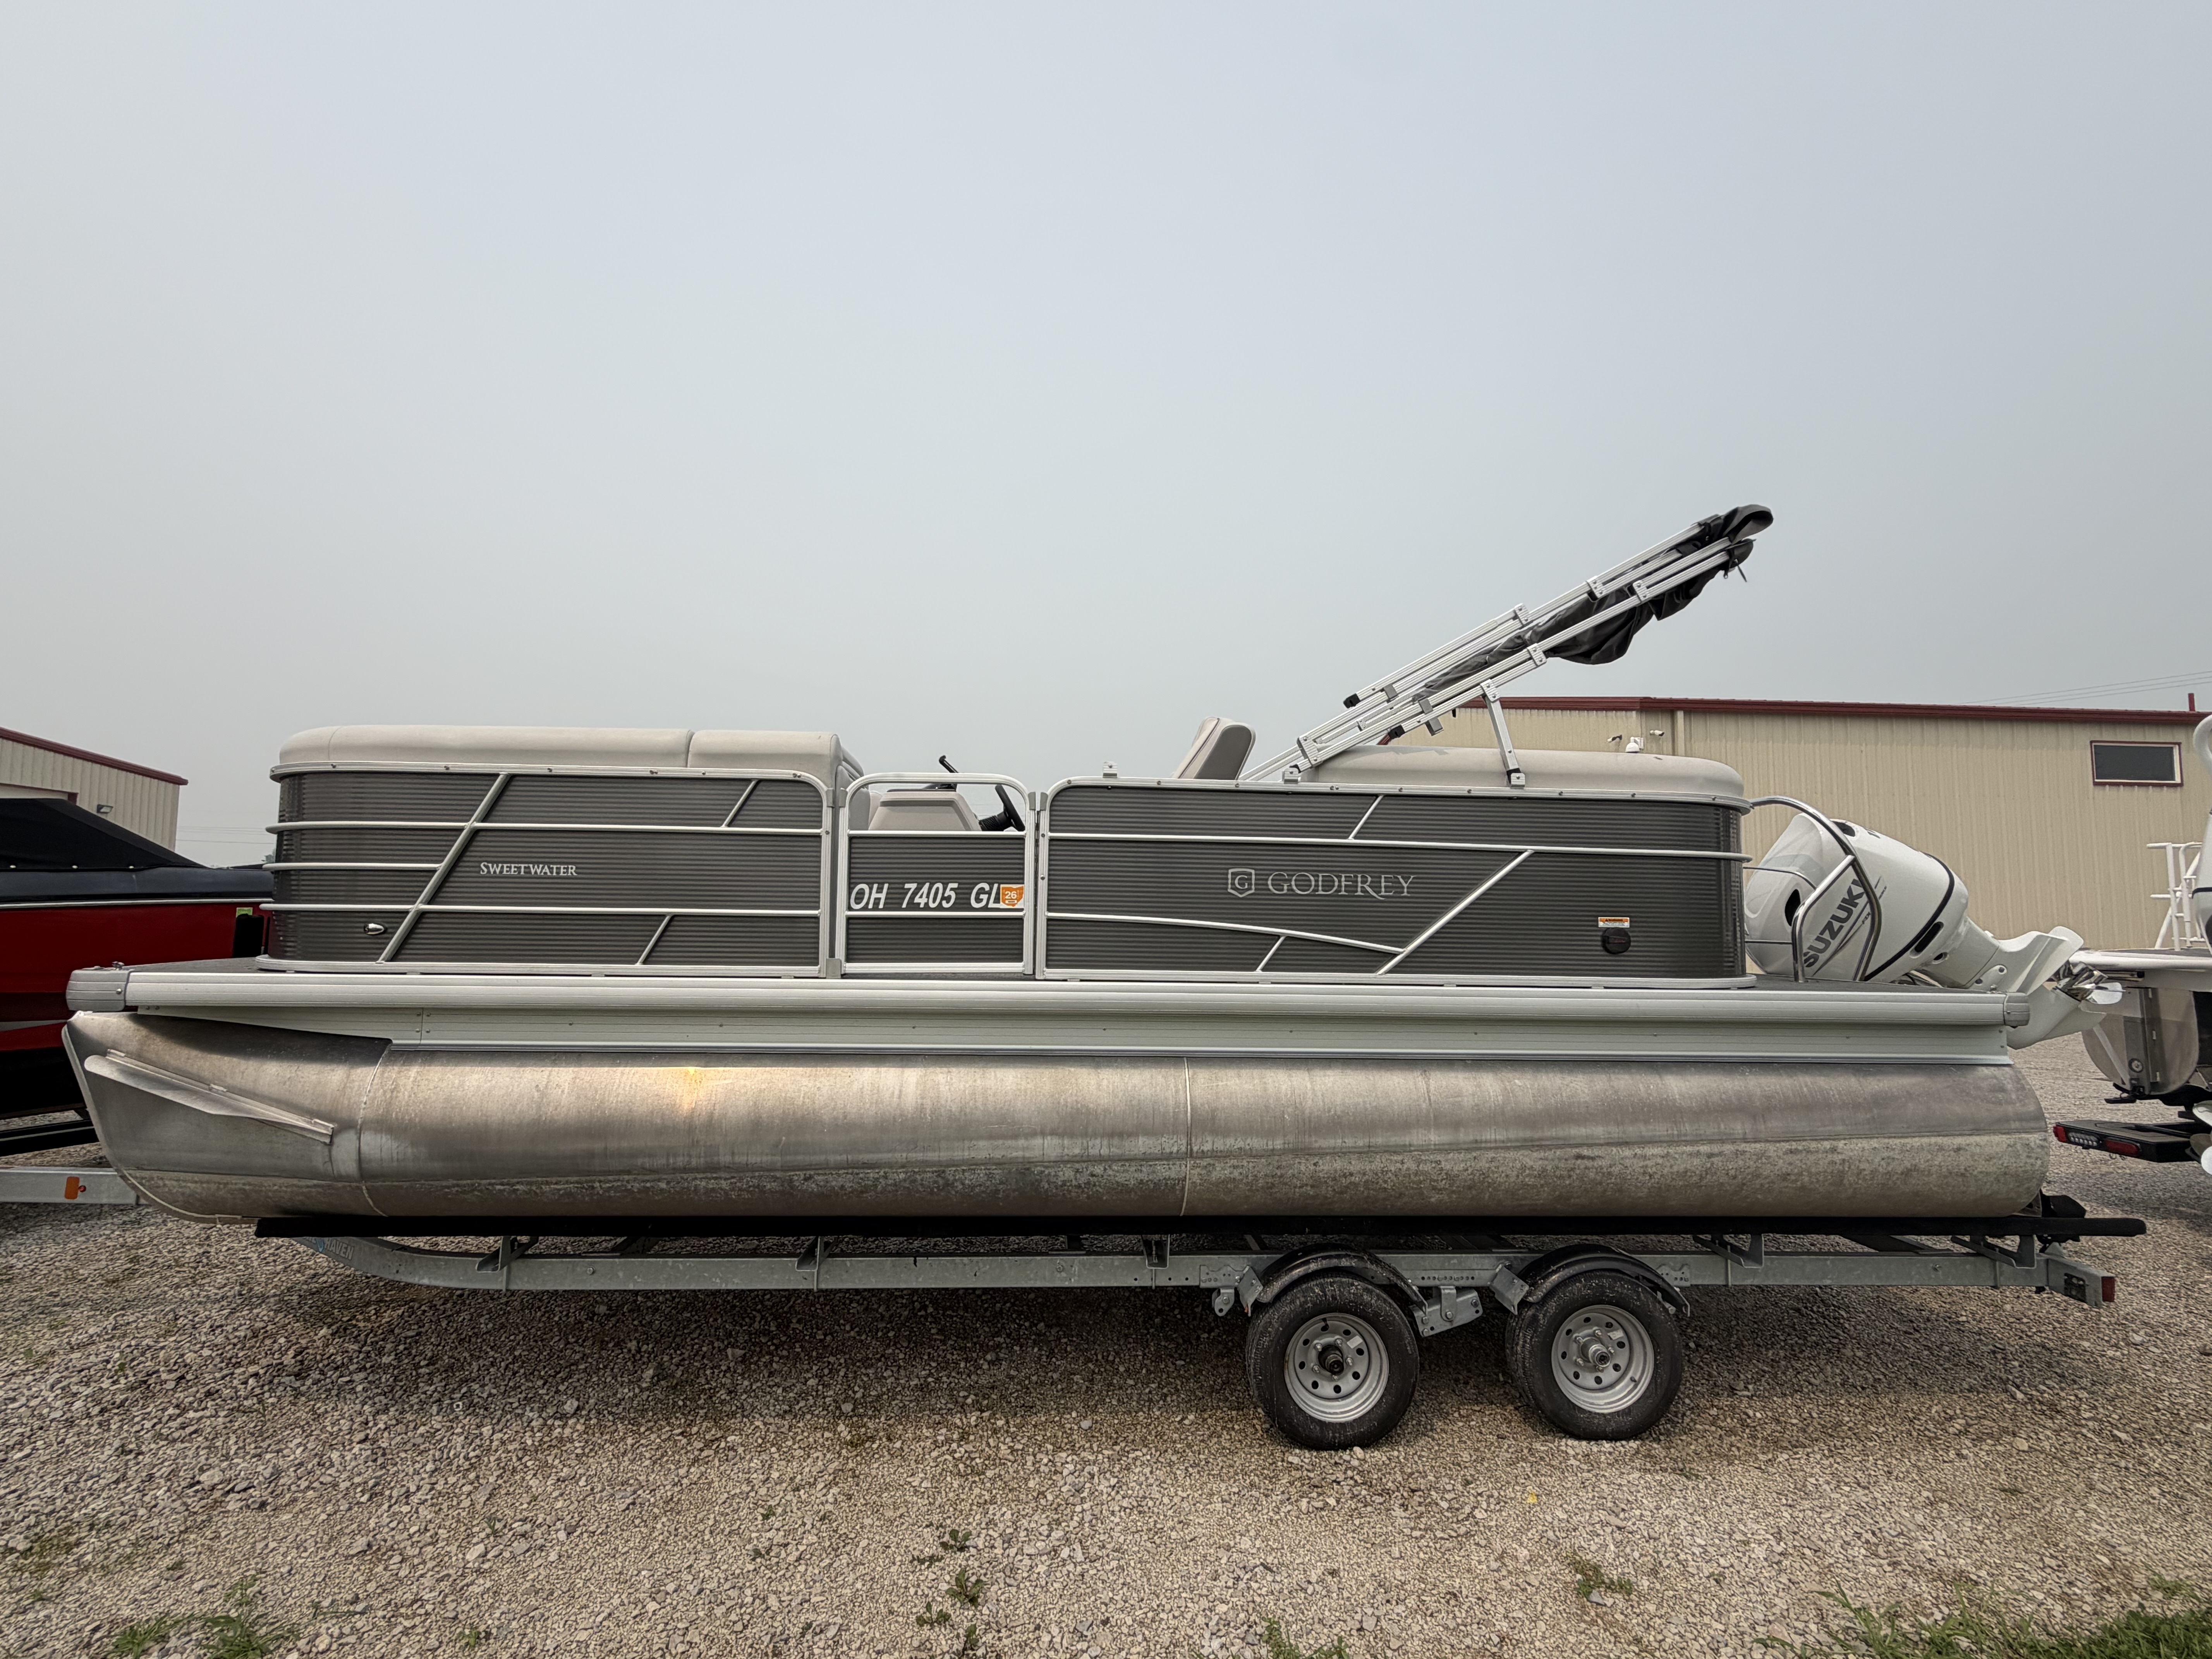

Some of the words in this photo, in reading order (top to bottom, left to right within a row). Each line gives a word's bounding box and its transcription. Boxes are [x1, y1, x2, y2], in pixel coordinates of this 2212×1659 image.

[480, 862, 578, 876] SWEETWATER
[850, 883, 889, 909] OH
[902, 882, 958, 908] 7405
[970, 882, 1001, 908] GL
[1005, 891, 1017, 899] 26
[1234, 875, 1248, 889] G
[1267, 872, 1417, 900] GODFREY
[1803, 878, 1865, 967] SUZUKI
[325, 1237, 354, 1261] HAVEN
